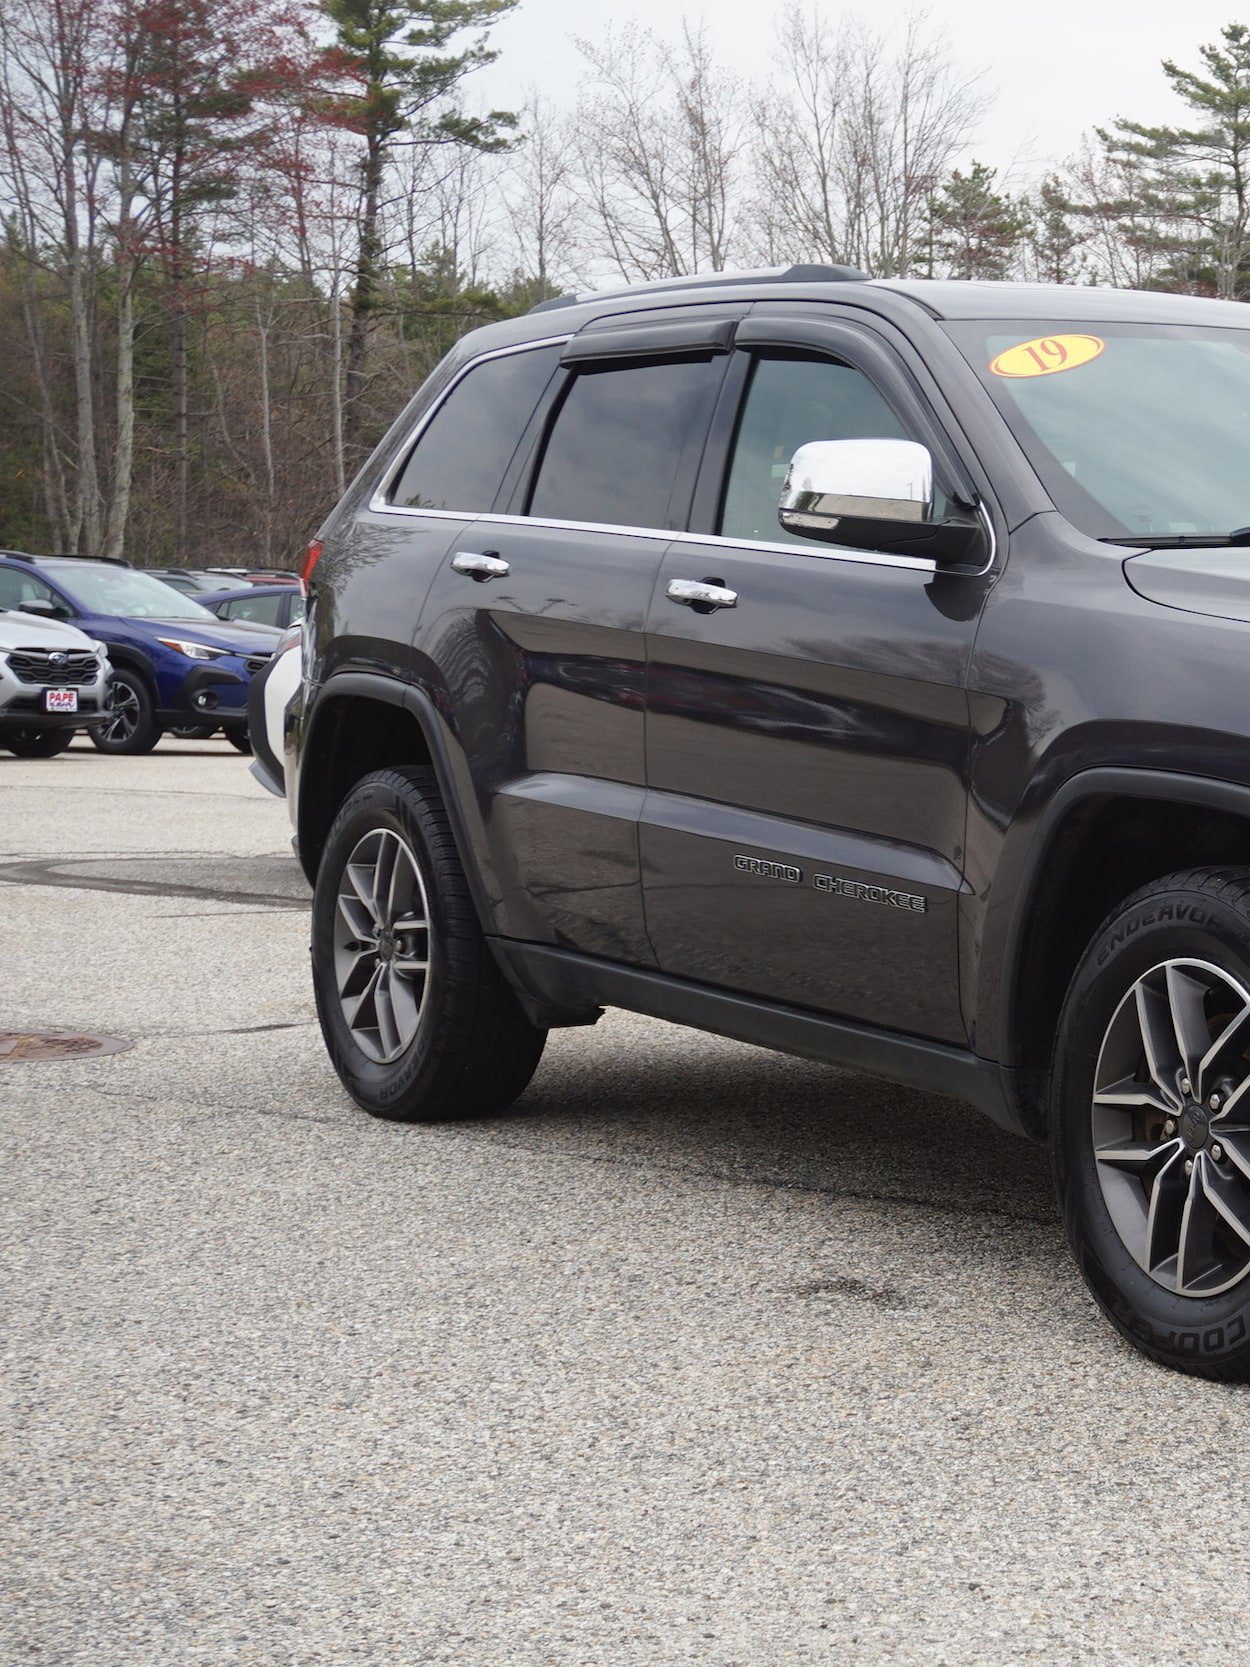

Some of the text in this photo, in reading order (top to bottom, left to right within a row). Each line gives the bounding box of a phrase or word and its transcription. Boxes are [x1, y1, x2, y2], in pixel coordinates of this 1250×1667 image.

[1022, 339, 1068, 373] 19
[48, 692, 74, 702] PAPE
[733, 854, 926, 913] GRAND CHEROKEE
